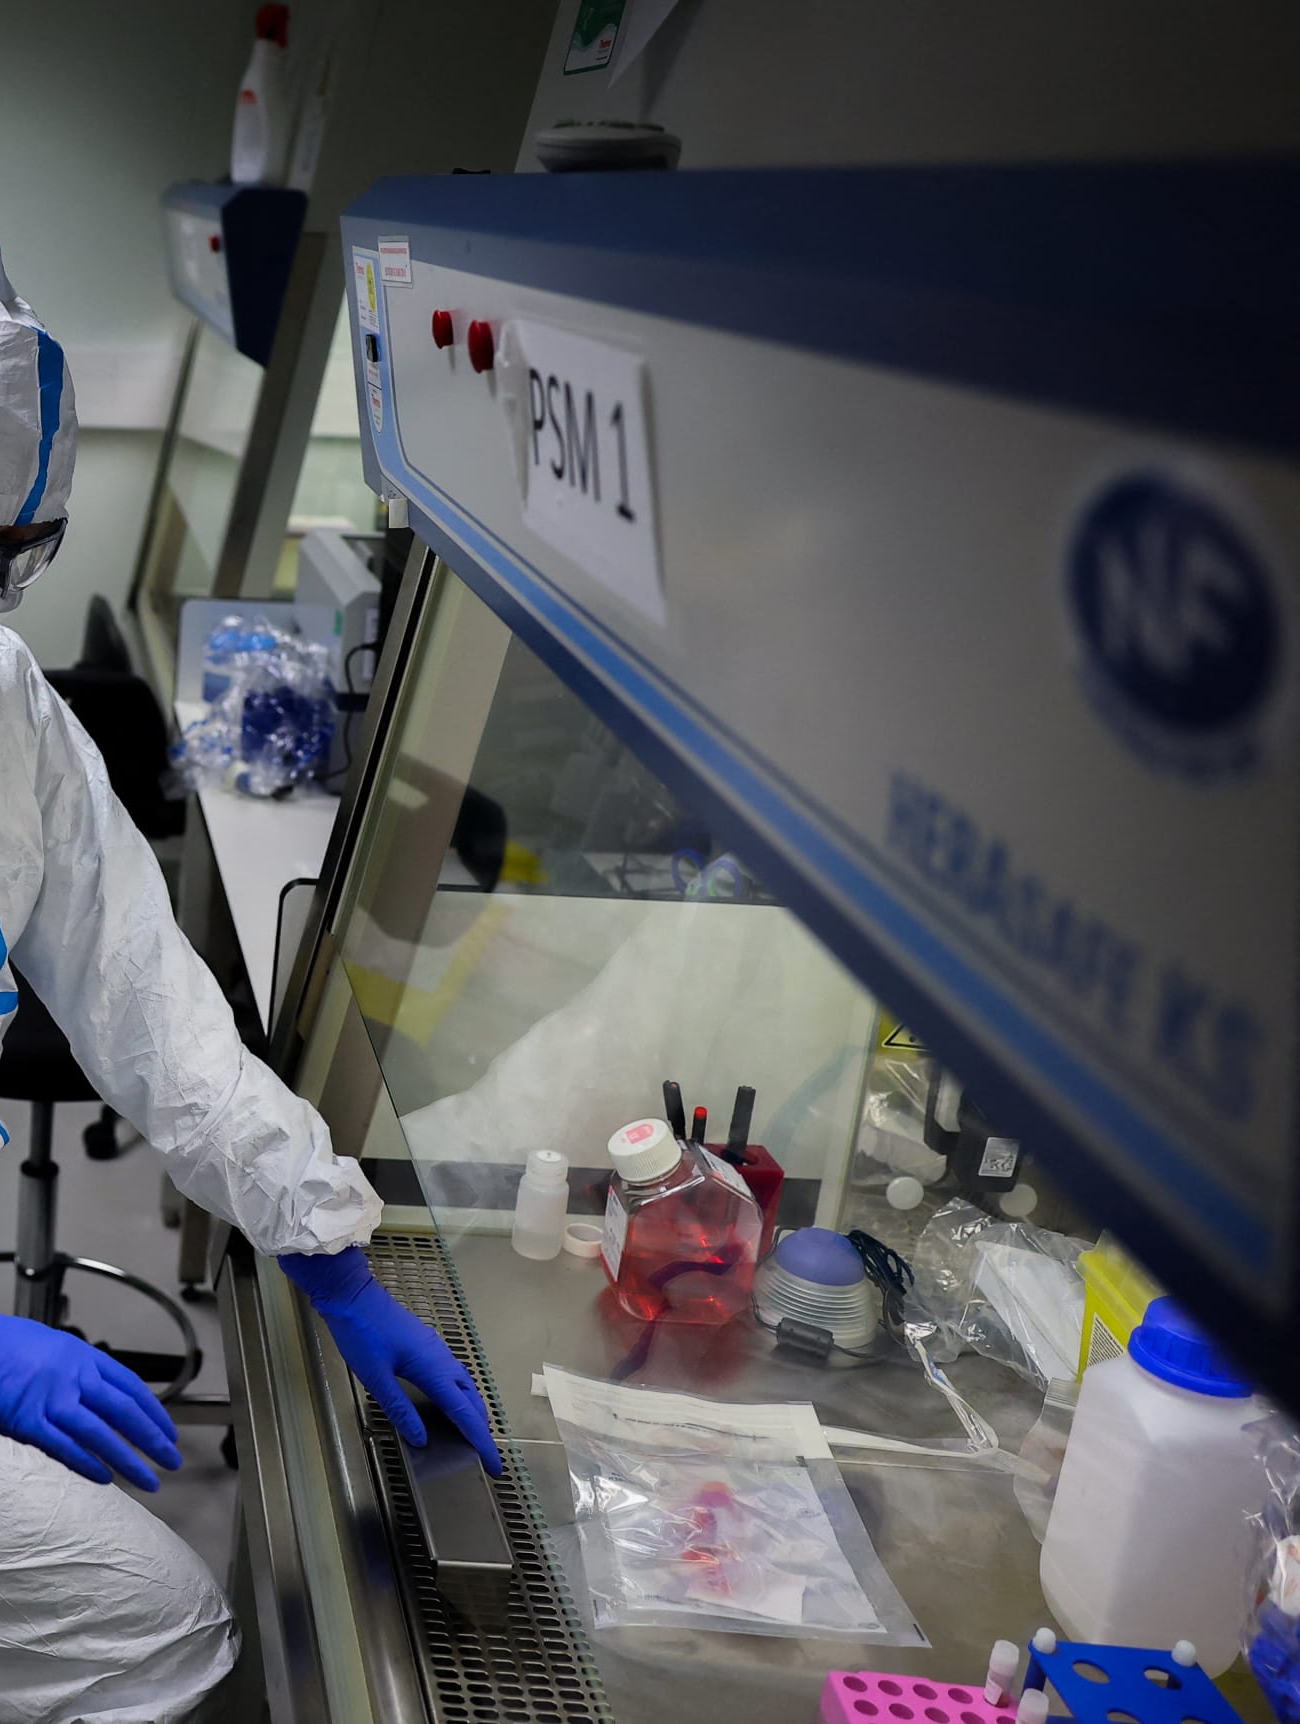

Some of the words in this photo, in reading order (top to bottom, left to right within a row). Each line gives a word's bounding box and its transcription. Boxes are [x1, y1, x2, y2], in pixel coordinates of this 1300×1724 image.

[529, 367, 601, 503] PSM
[611, 402, 638, 524] 1
[1096, 513, 1246, 678] NF
